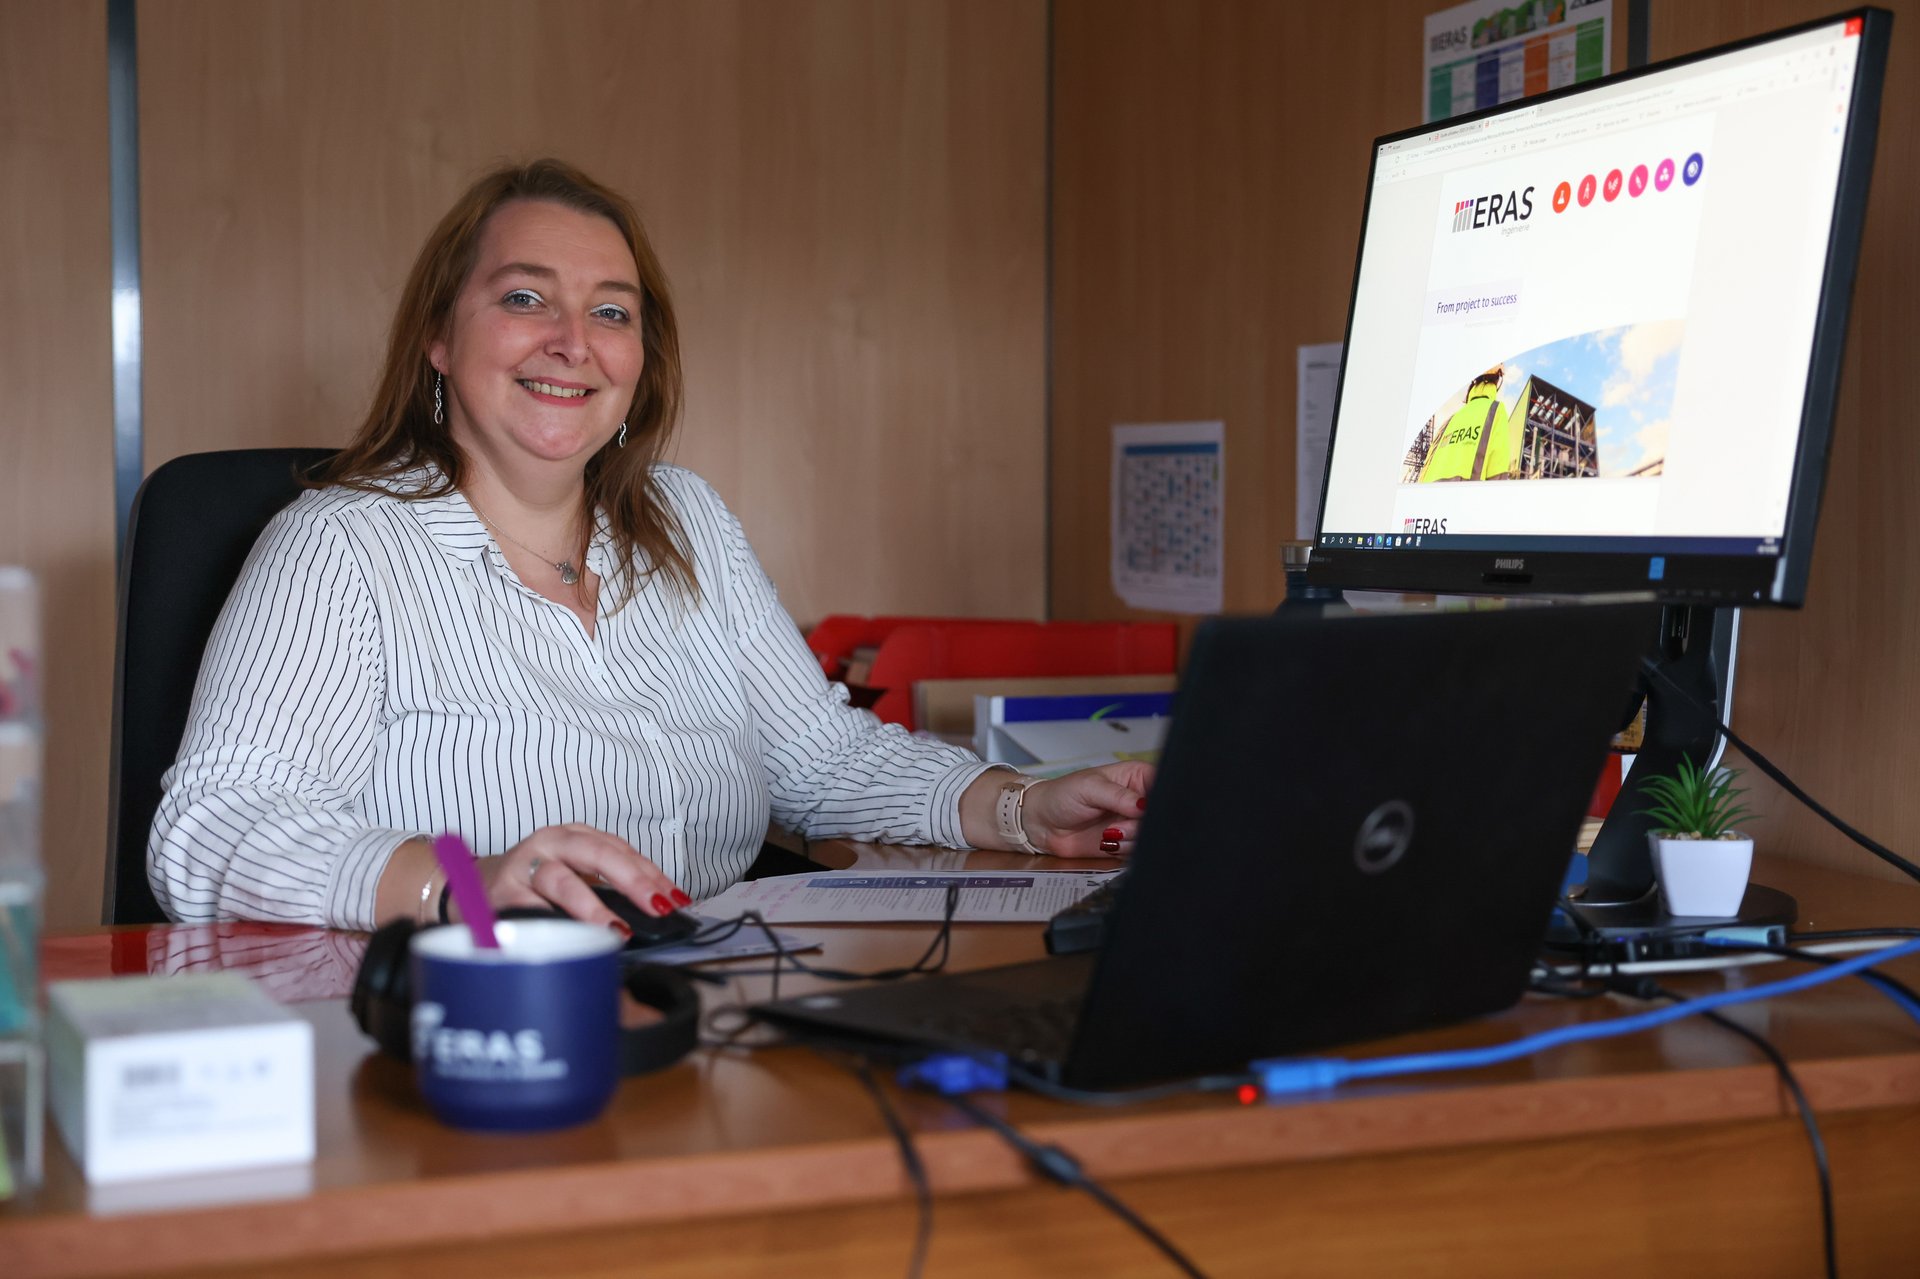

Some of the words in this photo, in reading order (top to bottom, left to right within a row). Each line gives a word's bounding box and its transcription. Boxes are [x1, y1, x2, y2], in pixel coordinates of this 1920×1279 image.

[1473, 186, 1535, 229] ERAS
[1437, 302, 1454, 314] From
[1456, 298, 1480, 315] project
[1482, 297, 1490, 307] to
[1491, 294, 1517, 306] success
[1449, 425, 1480, 444] ERAS
[1495, 559, 1524, 569] PHILIPS
[433, 1028, 544, 1063] ERAS
